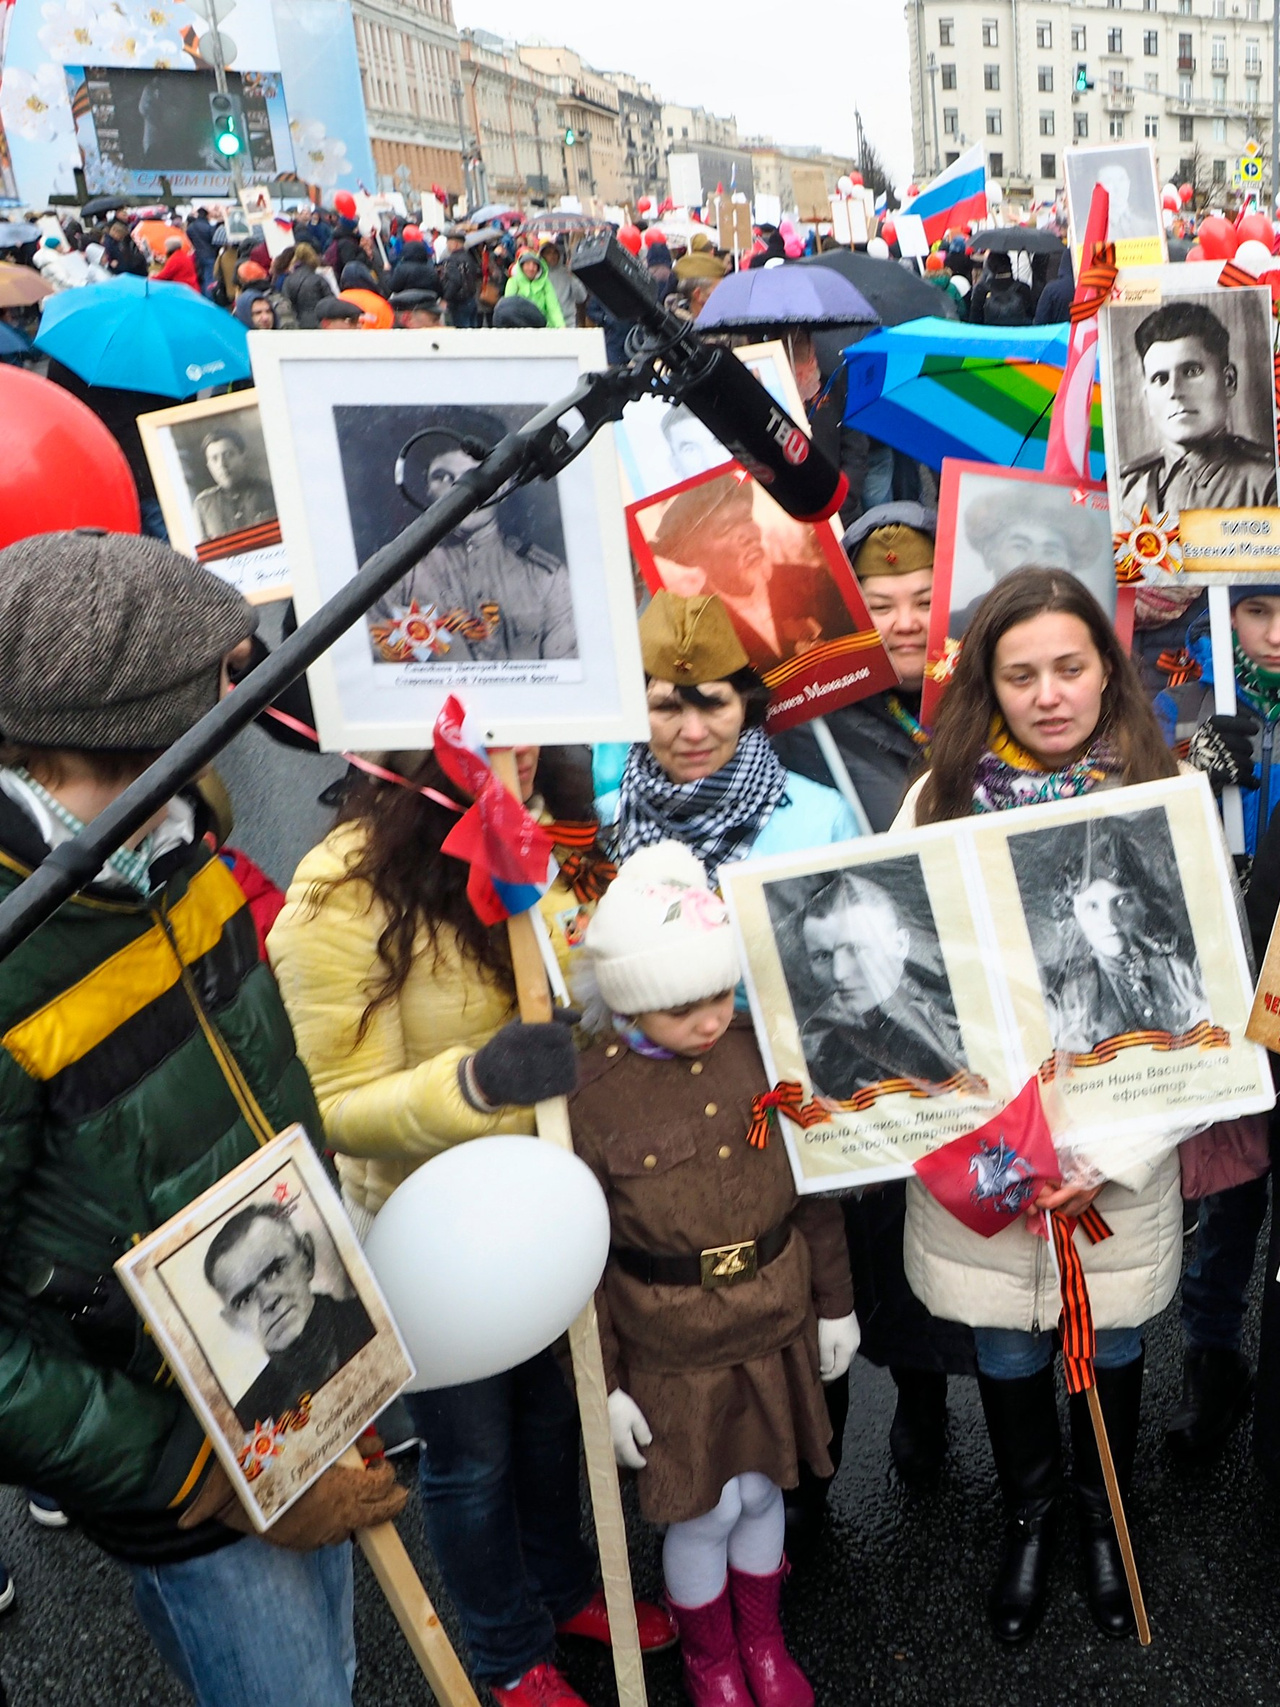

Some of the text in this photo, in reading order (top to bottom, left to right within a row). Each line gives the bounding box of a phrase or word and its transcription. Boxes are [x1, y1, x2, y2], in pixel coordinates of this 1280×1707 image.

[1221, 520, 1271, 536] ТИТОВ
[1112, 1080, 1187, 1103] ефрейтор
[804, 1128, 850, 1146] Серый
